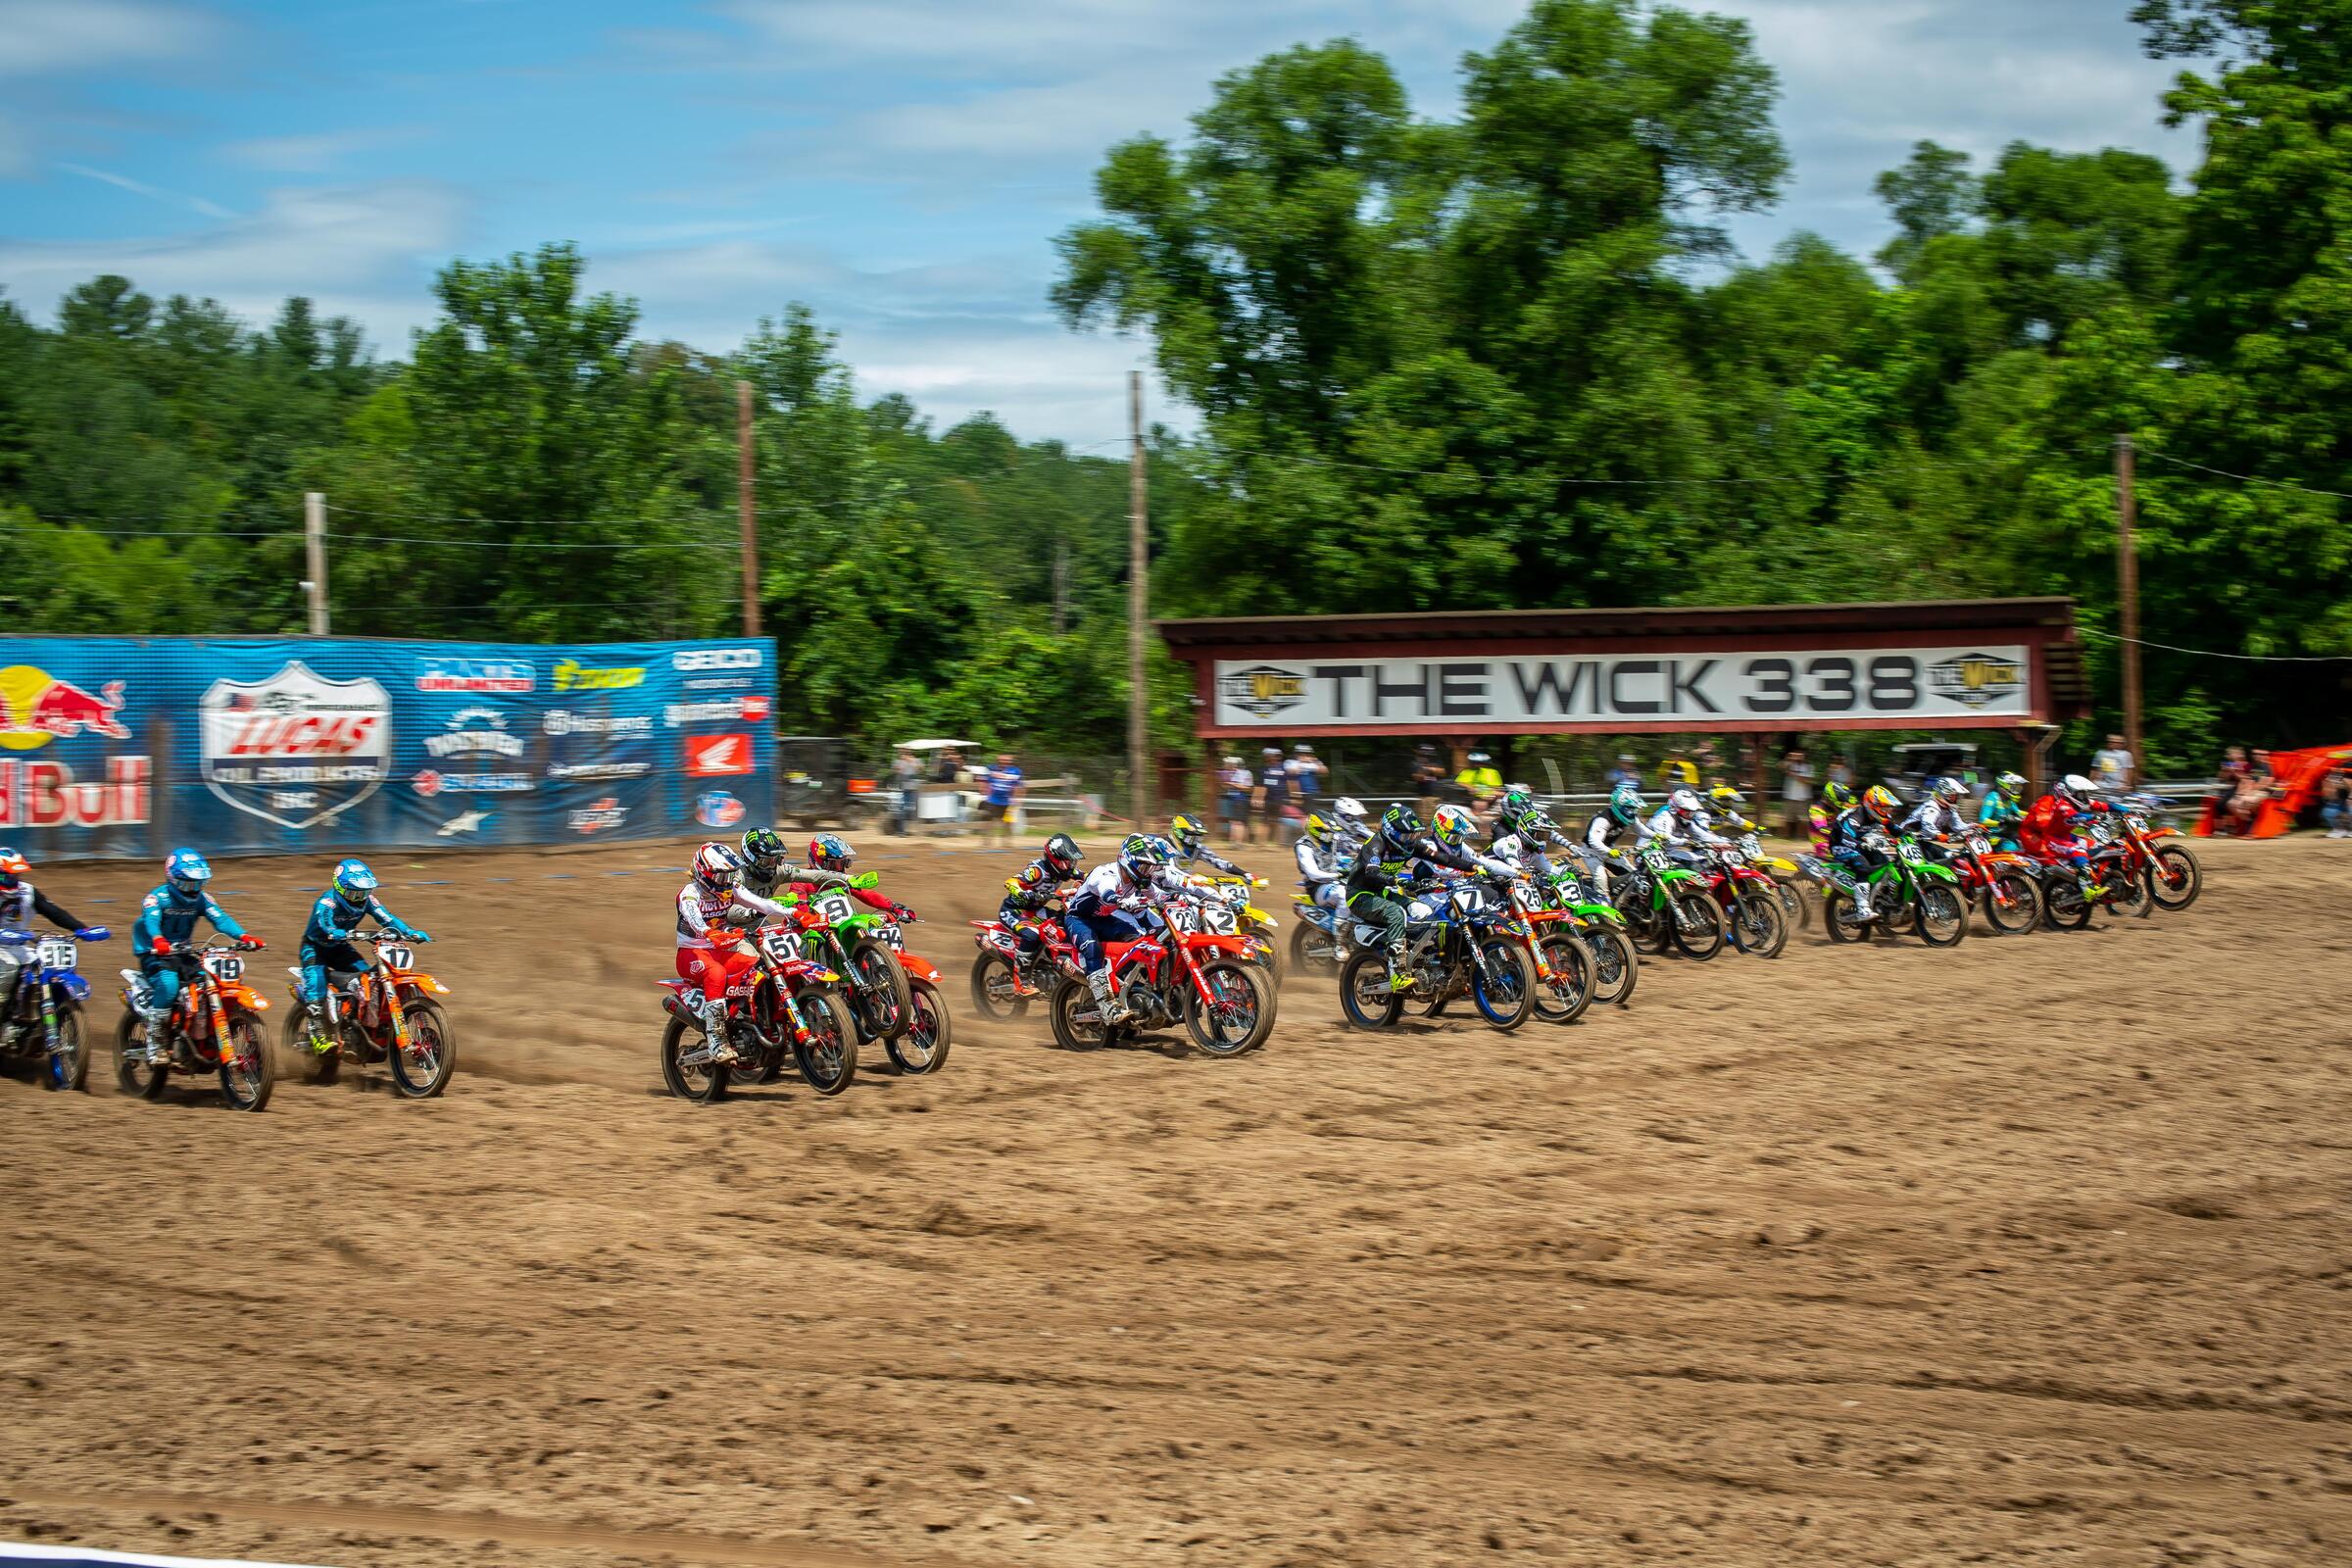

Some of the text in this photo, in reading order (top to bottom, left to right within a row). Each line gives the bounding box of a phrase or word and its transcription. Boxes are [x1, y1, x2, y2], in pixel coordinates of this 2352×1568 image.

[1314, 656, 1920, 717] THE WICK 338
[227, 717, 378, 754] LUCAS
[24, 757, 151, 826] Bull
[1228, 888, 1250, 902] 34
[1462, 891, 1478, 909] 7
[1524, 889, 1542, 906] 25
[1562, 884, 1582, 903] 3
[824, 899, 849, 922] 9
[1176, 911, 1197, 932] 23
[1216, 911, 1234, 932] 2
[1361, 927, 1382, 944] 7
[768, 934, 799, 960] 51
[385, 949, 411, 968] 17
[212, 959, 240, 980] 19
[726, 986, 756, 997] GASGAS
